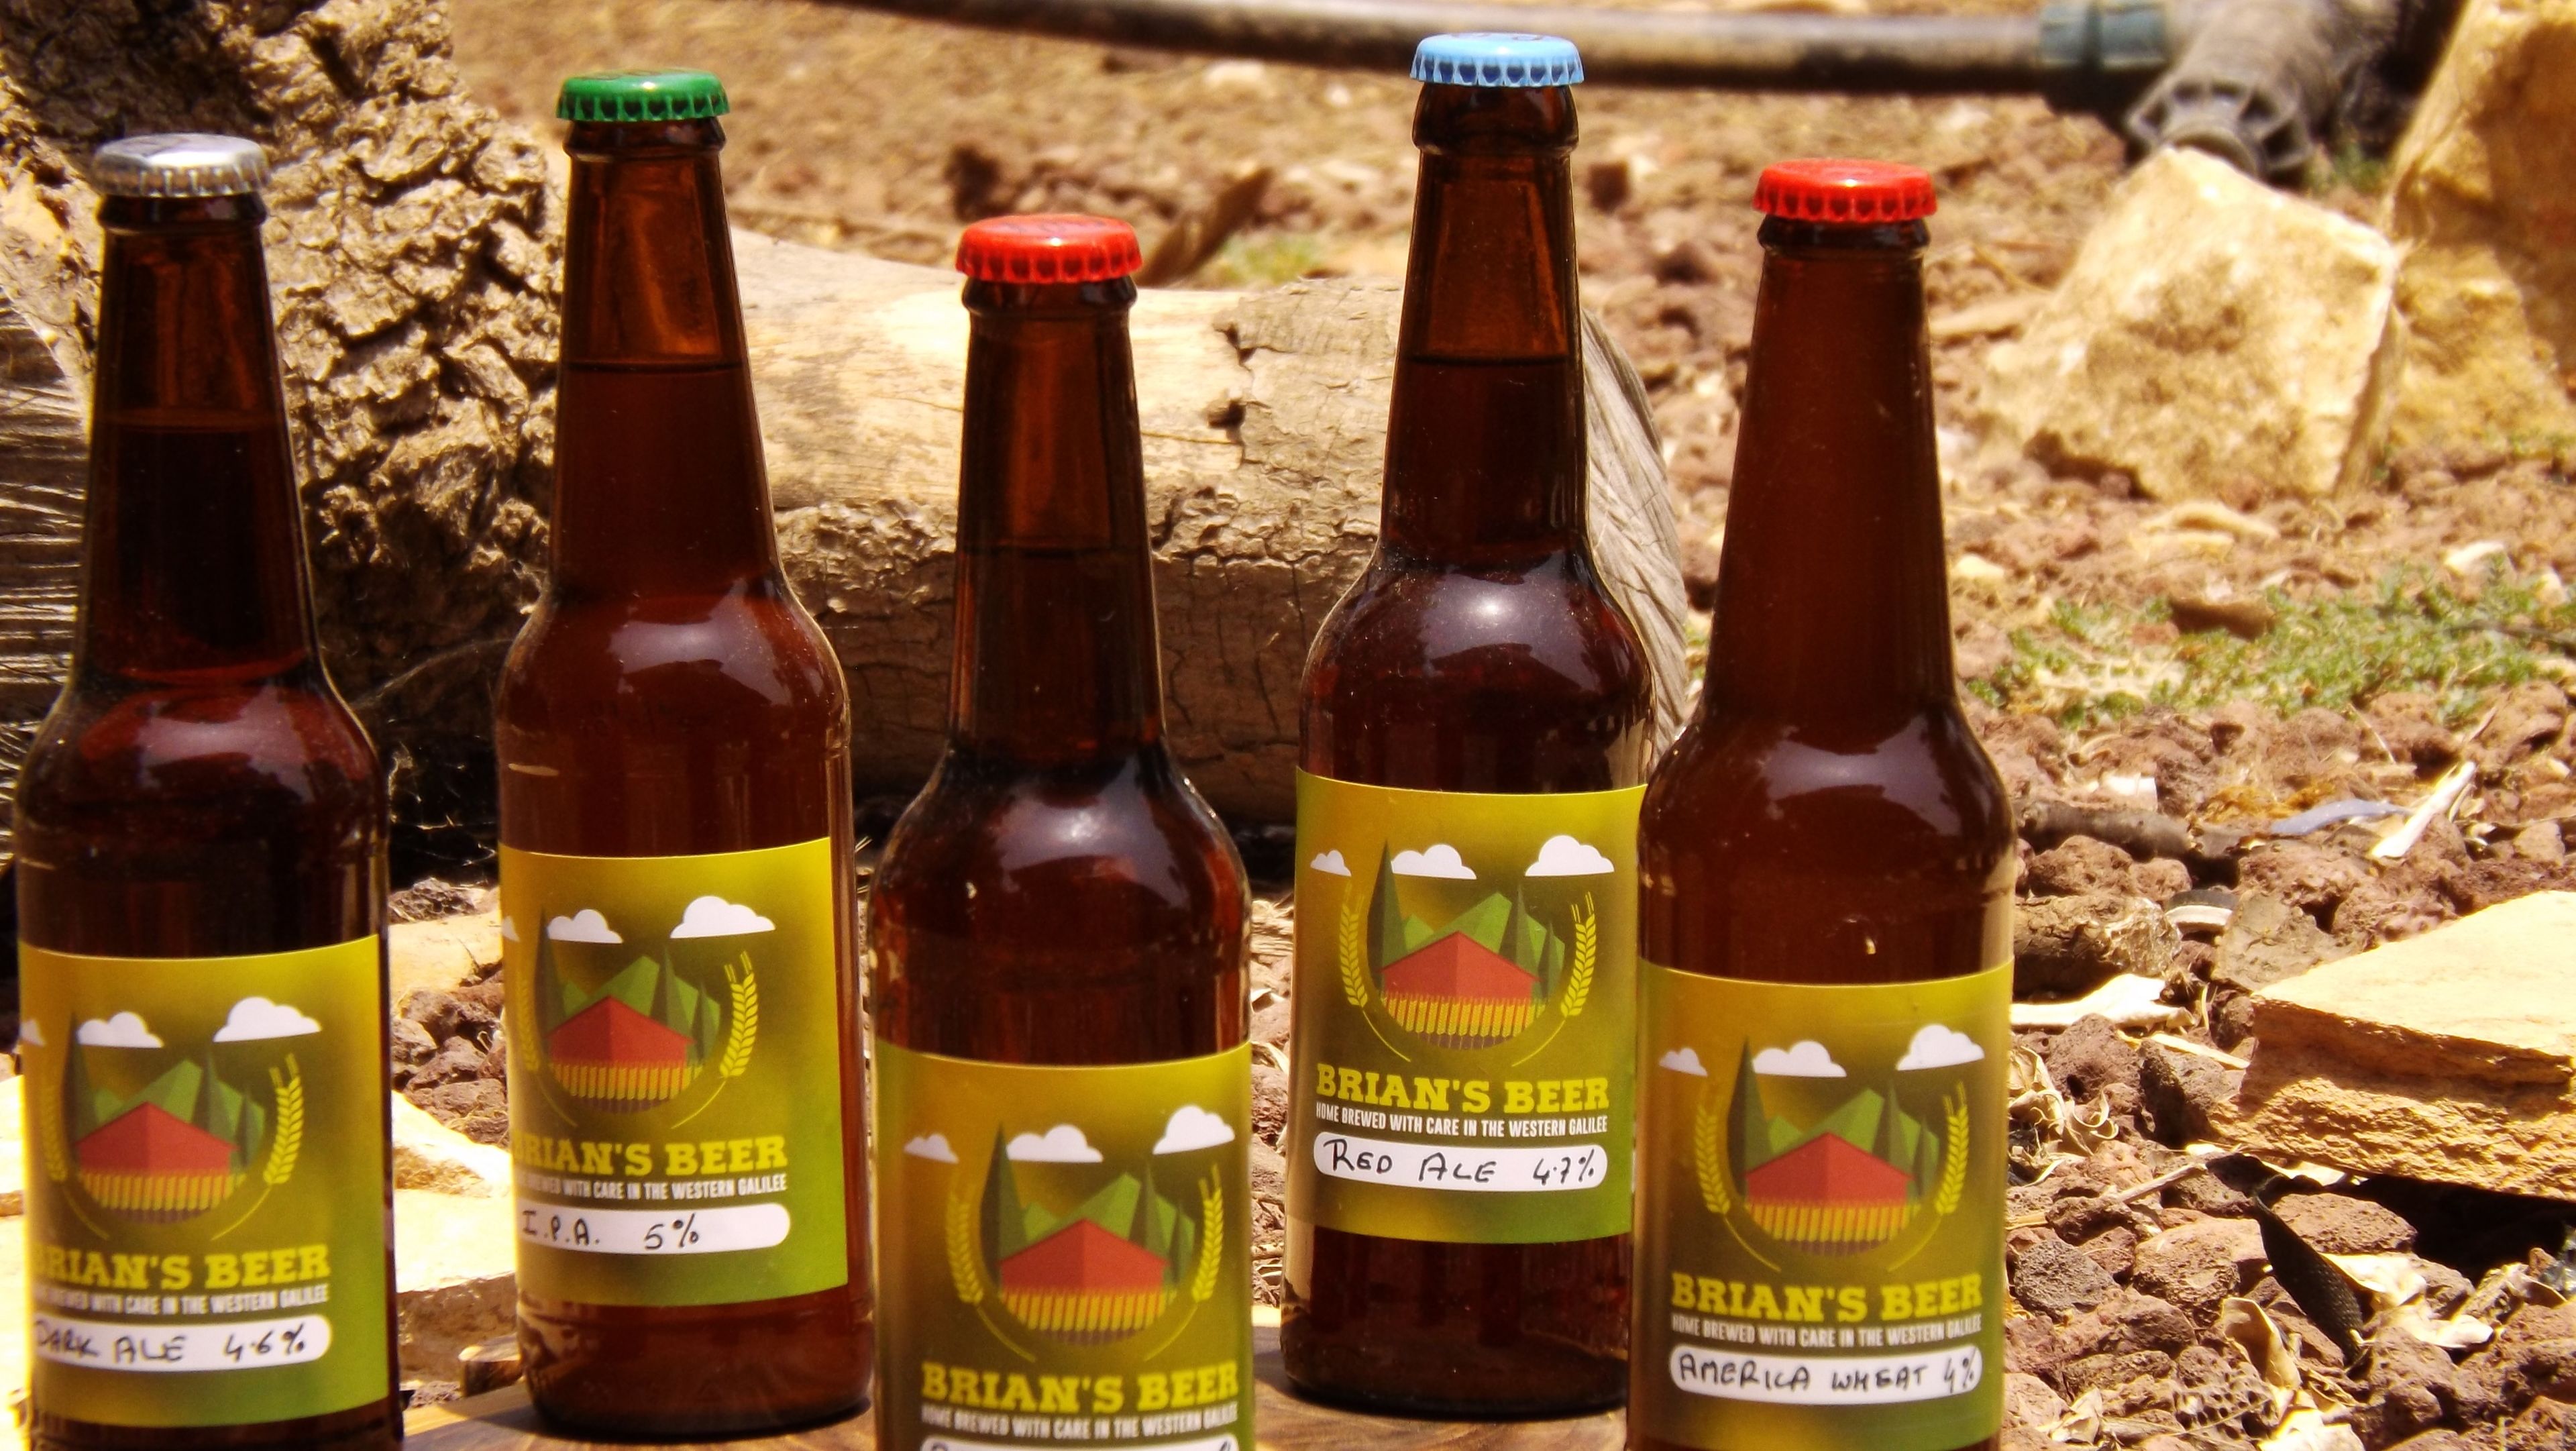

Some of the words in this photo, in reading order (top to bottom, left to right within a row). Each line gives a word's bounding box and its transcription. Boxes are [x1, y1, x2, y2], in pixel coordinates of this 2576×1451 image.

[1316, 1063, 1491, 1113] BRIAN'S
[1504, 1077, 1609, 1114] BEER
[1316, 1102, 1339, 1123] HOME
[1342, 1108, 1386, 1130] BREWED
[1390, 1114, 1422, 1134] WITH
[1426, 1117, 1459, 1136] CARE
[1463, 1119, 1477, 1136] IN
[1481, 1120, 1505, 1137] THE
[1509, 1119, 1566, 1137] WESTERN
[1569, 1115, 1608, 1135] GALILEE
[665, 1136, 788, 1176] BEER
[1323, 1138, 1393, 1175] RED
[1418, 1152, 1497, 1183] ALE
[563, 1179, 592, 1198] WITH
[593, 1181, 625, 1199] CARE
[627, 1181, 641, 1200] IN
[643, 1181, 668, 1200] THE
[671, 1179, 735, 1200] WESTERN
[738, 1173, 788, 1196] GALILEE
[523, 1210, 600, 1246] I.P.A.
[644, 1212, 700, 1250] 5%
[205, 1244, 331, 1290] BEER
[91, 1292, 122, 1313] WITH
[124, 1295, 160, 1315] CARE
[162, 1295, 178, 1315] IN
[180, 1295, 209, 1315] THE
[210, 1290, 276, 1313] WESTERN
[279, 1282, 329, 1309] GALILEE
[1671, 1272, 1868, 1322] BRIAN'S
[1880, 1273, 1983, 1321] BEER
[114, 1335, 186, 1364] ALE
[1671, 1313, 1700, 1336] HOME
[1703, 1319, 1756, 1344] BREWED
[1758, 1325, 1796, 1347] WITH
[1799, 1327, 1836, 1348] CARE
[1839, 1327, 1855, 1348] IN
[1858, 1327, 1884, 1348] THE
[1886, 1322, 1945, 1346] WESTERN
[921, 1361, 1125, 1413] BRIAN'S
[1137, 1360, 1238, 1410] BEER
[1679, 1353, 1811, 1391] AMERICA
[1831, 1364, 1928, 1393] WHEAT
[954, 1408, 1009, 1436] BREWED
[1012, 1415, 1051, 1438] WITH
[1053, 1417, 1091, 1440] CARE
[1093, 1417, 1110, 1440] IN
[1114, 1417, 1140, 1440] THE
[1142, 1410, 1202, 1437] WESTERN
